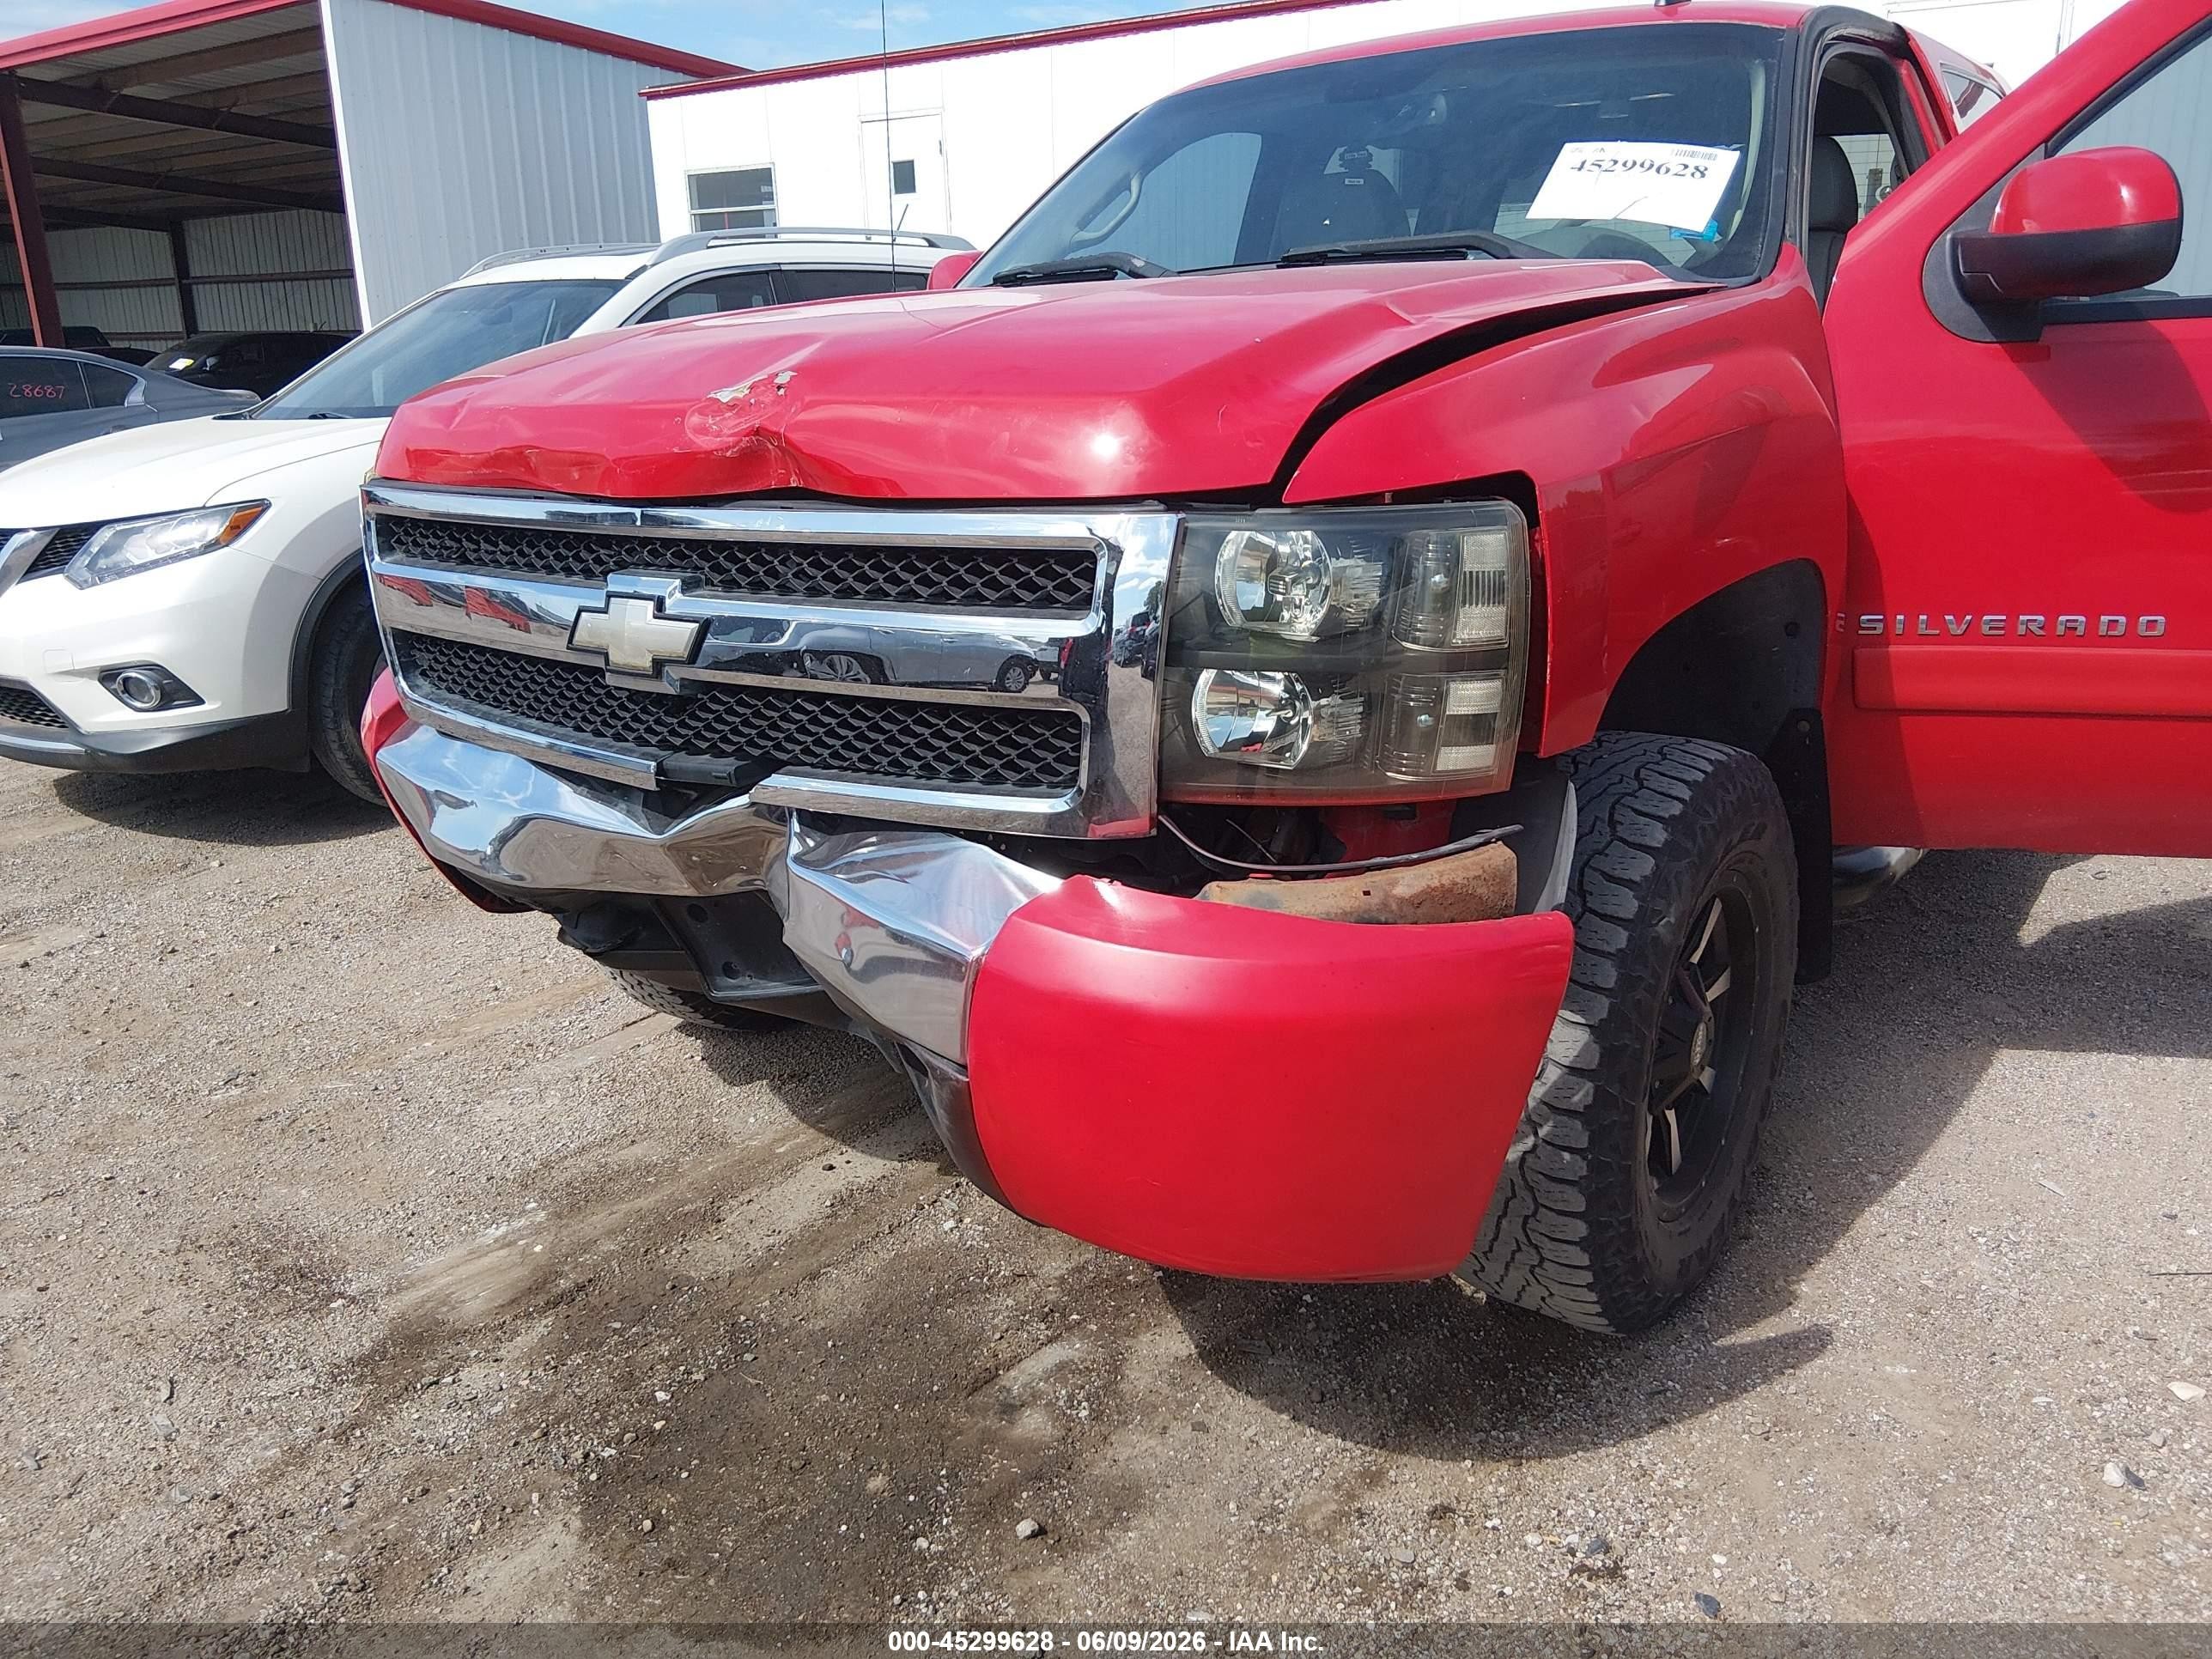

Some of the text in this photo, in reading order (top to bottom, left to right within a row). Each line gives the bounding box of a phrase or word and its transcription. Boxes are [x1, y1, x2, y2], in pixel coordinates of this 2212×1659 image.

[1570, 158, 1709, 179] 45299628
[8, 383, 65, 399] 28687
[1857, 614, 2166, 636] SILVERADO
